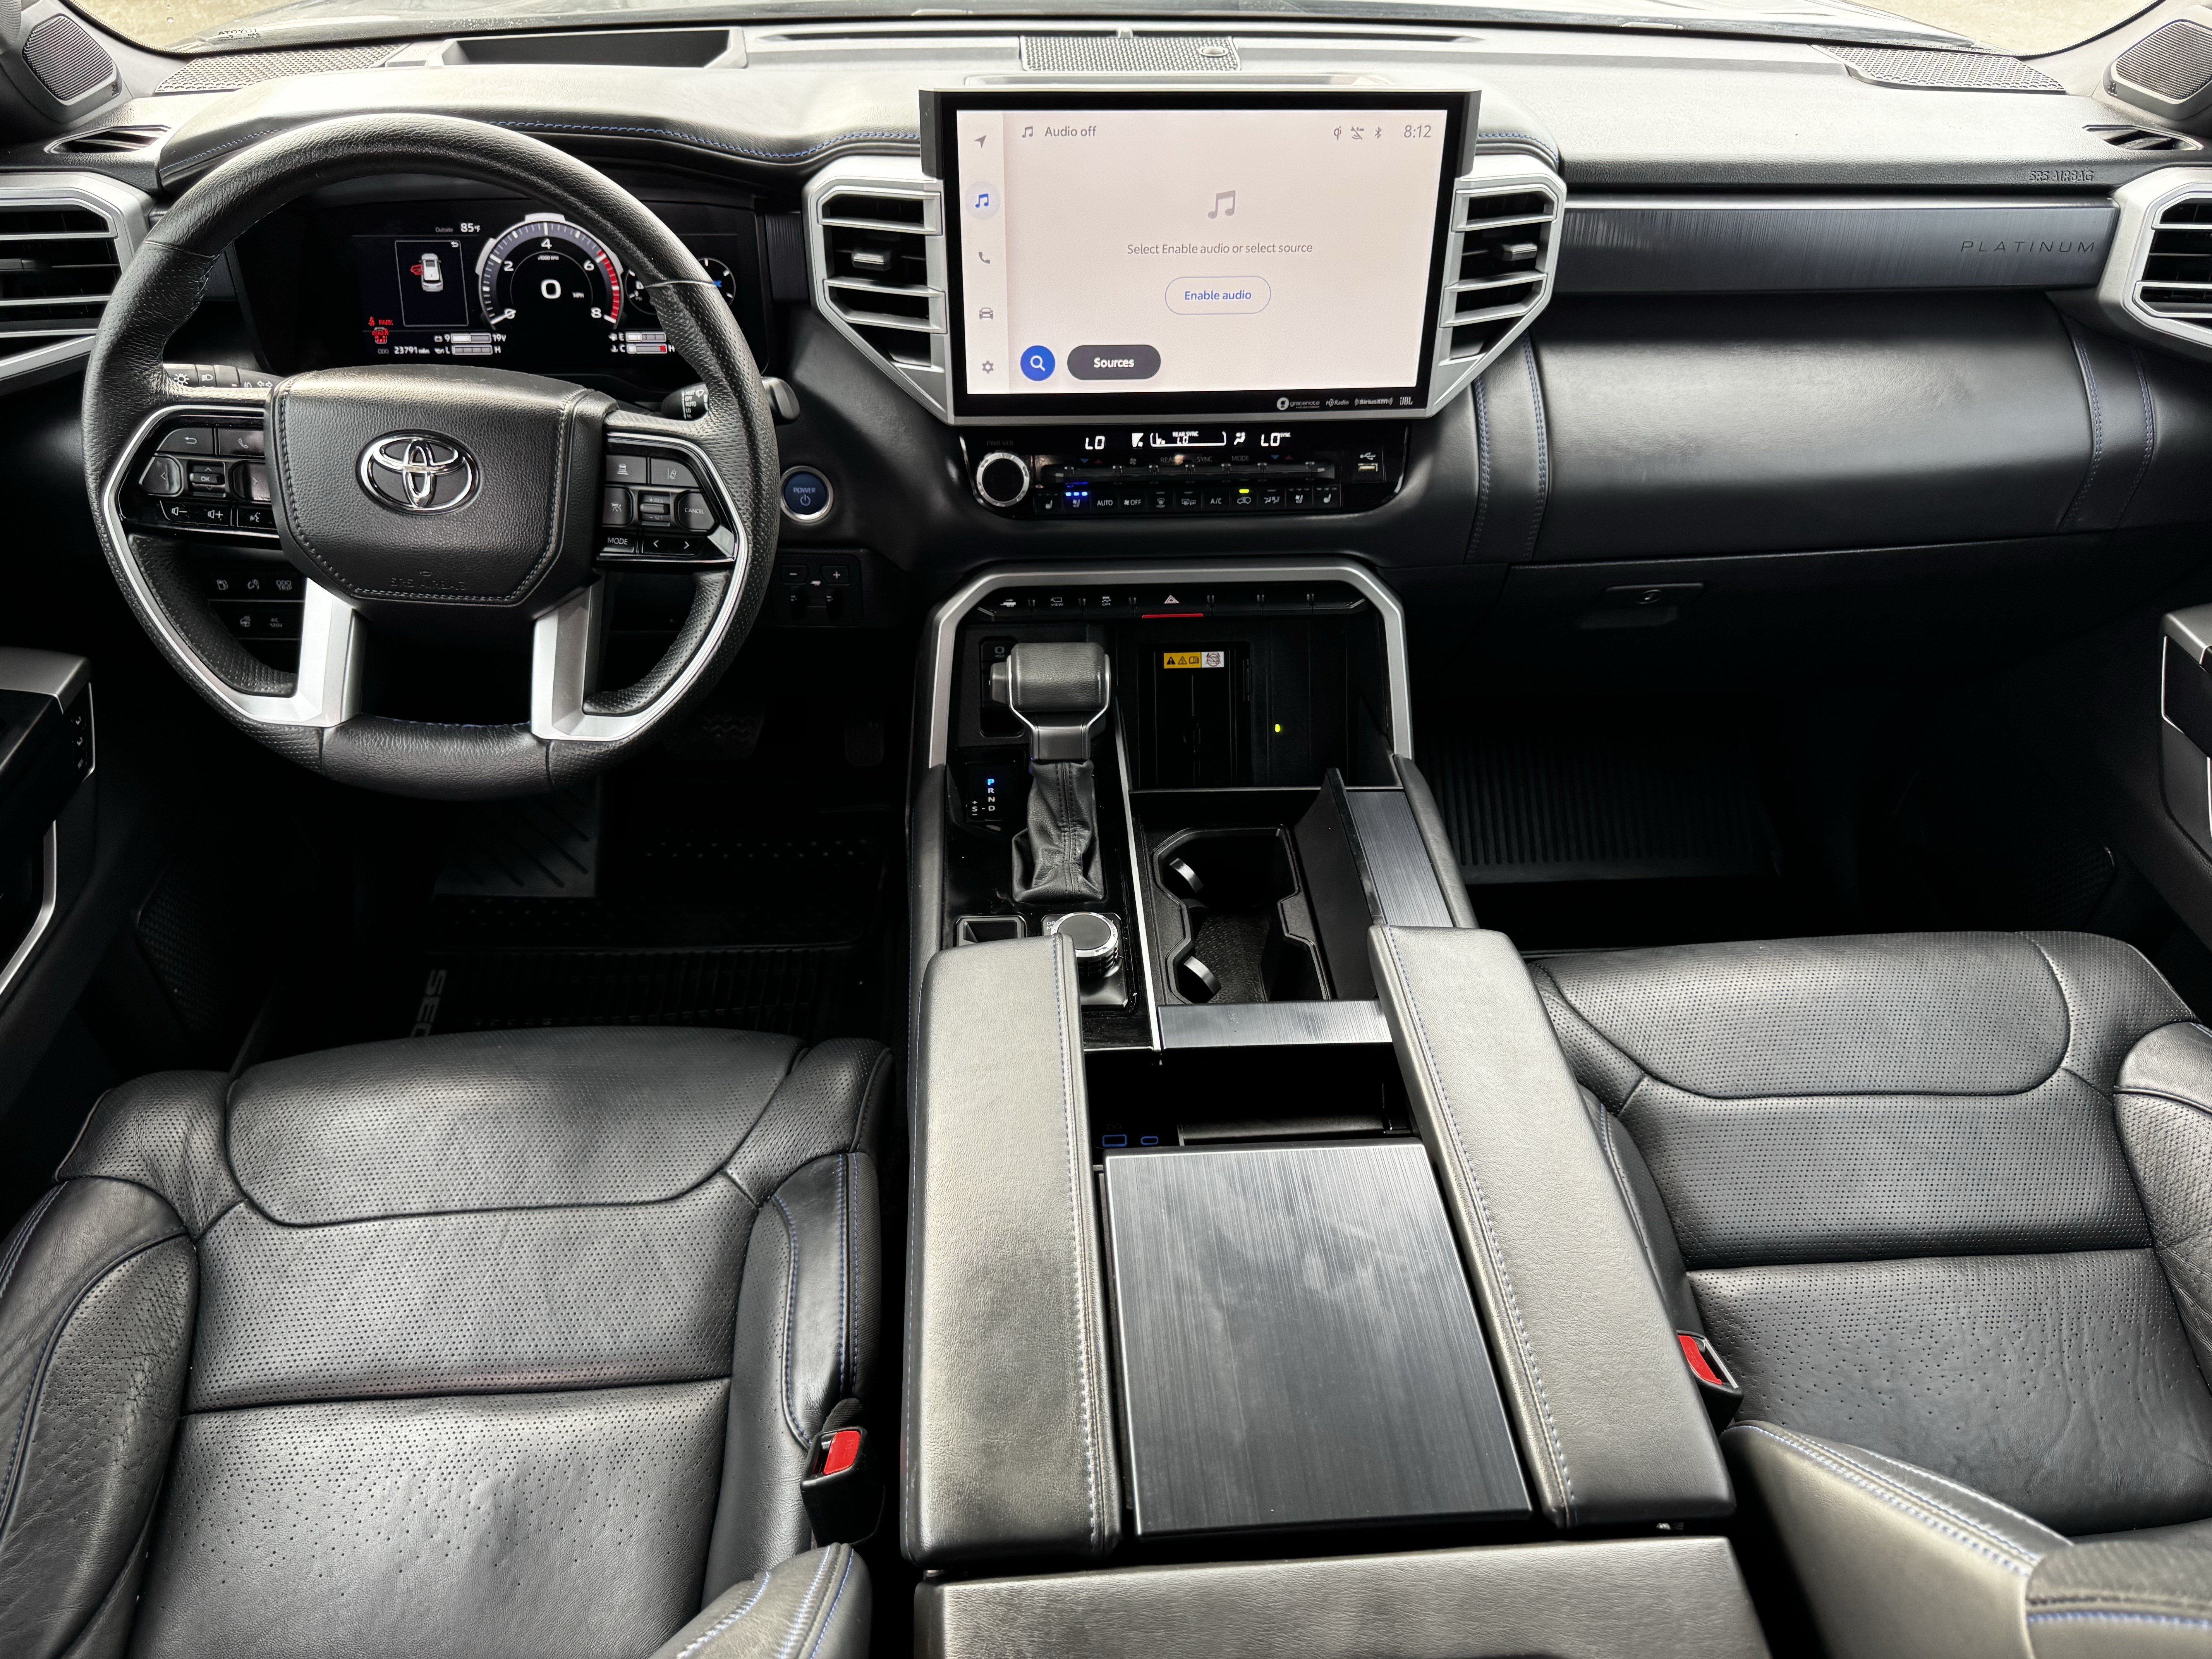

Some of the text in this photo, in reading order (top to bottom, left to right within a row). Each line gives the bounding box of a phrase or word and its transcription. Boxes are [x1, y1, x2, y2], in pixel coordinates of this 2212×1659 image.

[1045, 126, 1097, 136] Audio off
[1404, 125, 1431, 138] 8:12
[2029, 170, 2095, 182] SRS AIRBAG
[541, 238, 552, 249] 4
[1127, 243, 1313, 254] Select Enable audio or select source
[1960, 241, 2095, 252] PLATINUM
[504, 261, 514, 271] 2
[584, 259, 594, 271] 6
[541, 279, 561, 299] 0
[1185, 290, 1252, 300] Enable audio
[591, 307, 602, 318] 8
[1094, 357, 1134, 368] Sources
[1400, 396, 1413, 405] JBL
[1085, 435, 1105, 450] LO
[1261, 433, 1280, 447] LO
